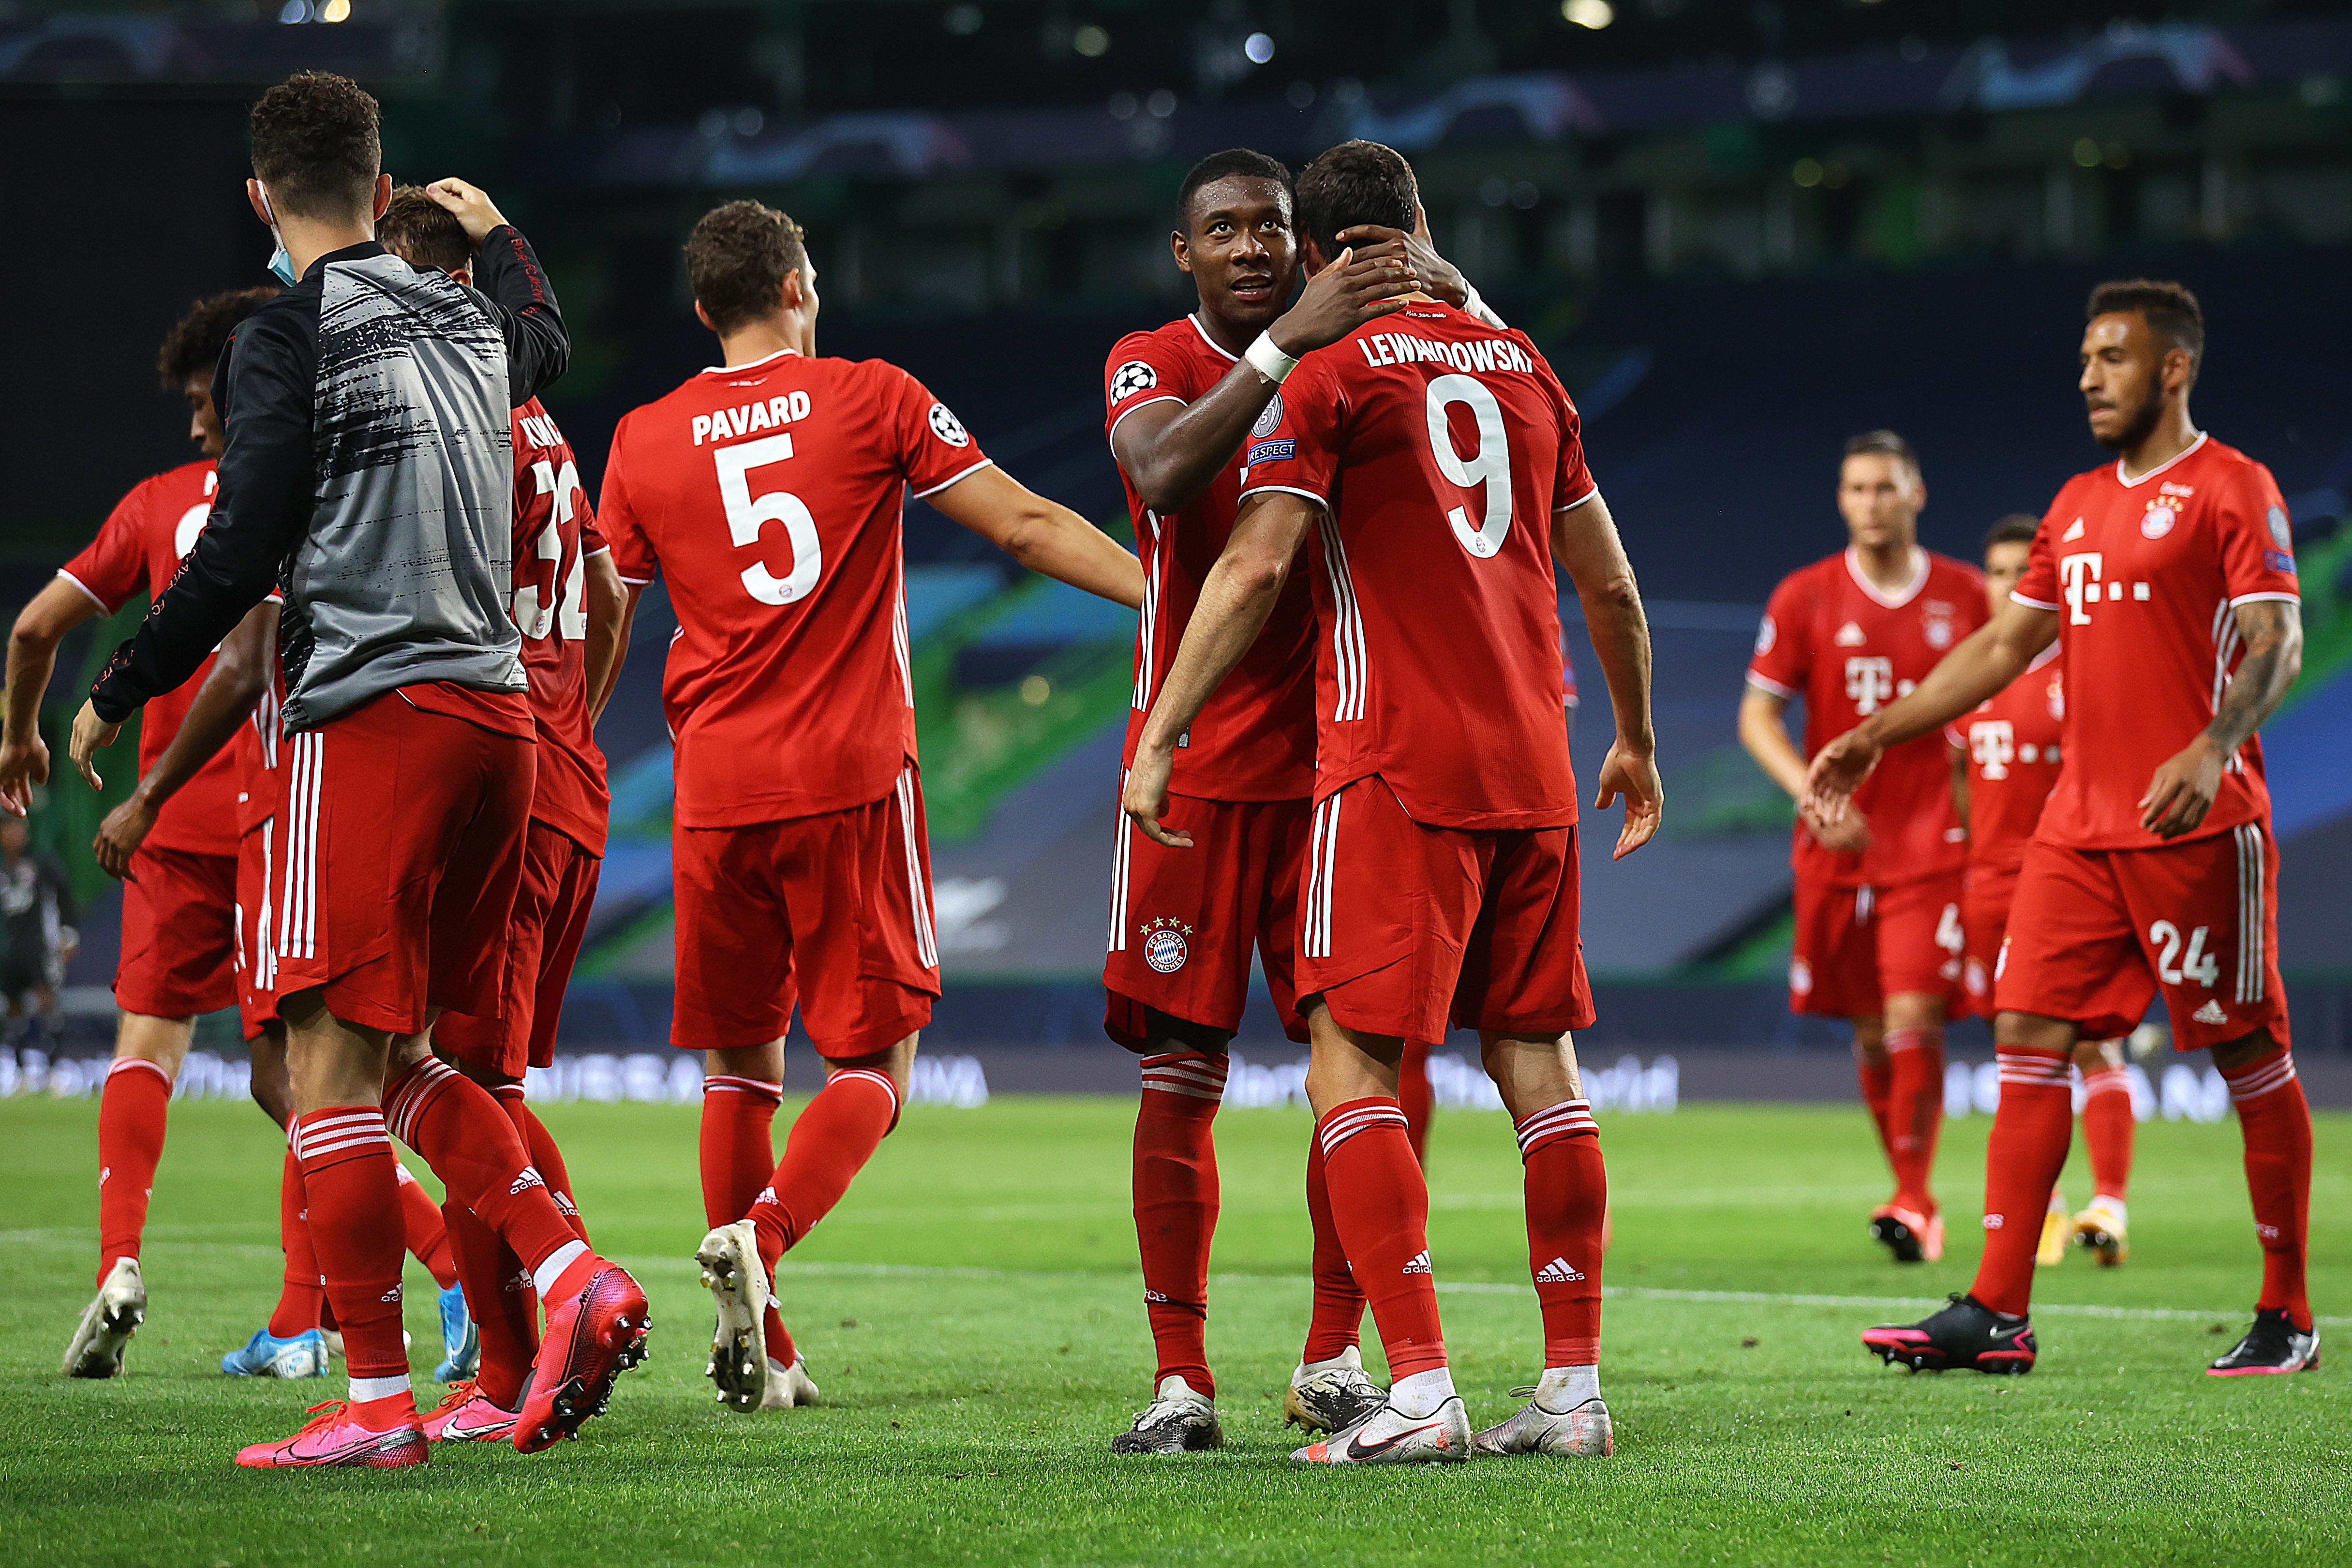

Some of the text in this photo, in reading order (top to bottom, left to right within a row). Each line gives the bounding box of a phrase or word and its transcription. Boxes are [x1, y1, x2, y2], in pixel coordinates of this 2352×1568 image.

[692, 389, 811, 447] PAVARD
[1250, 444, 1295, 462] RESPECT
[1426, 373, 1512, 558] 9
[514, 460, 587, 640] 32
[713, 432, 822, 606] 5
[1148, 933, 1184, 949] FC BAYERN
[2149, 919, 2219, 988] 24
[1536, 1272, 1586, 1283] adidas
